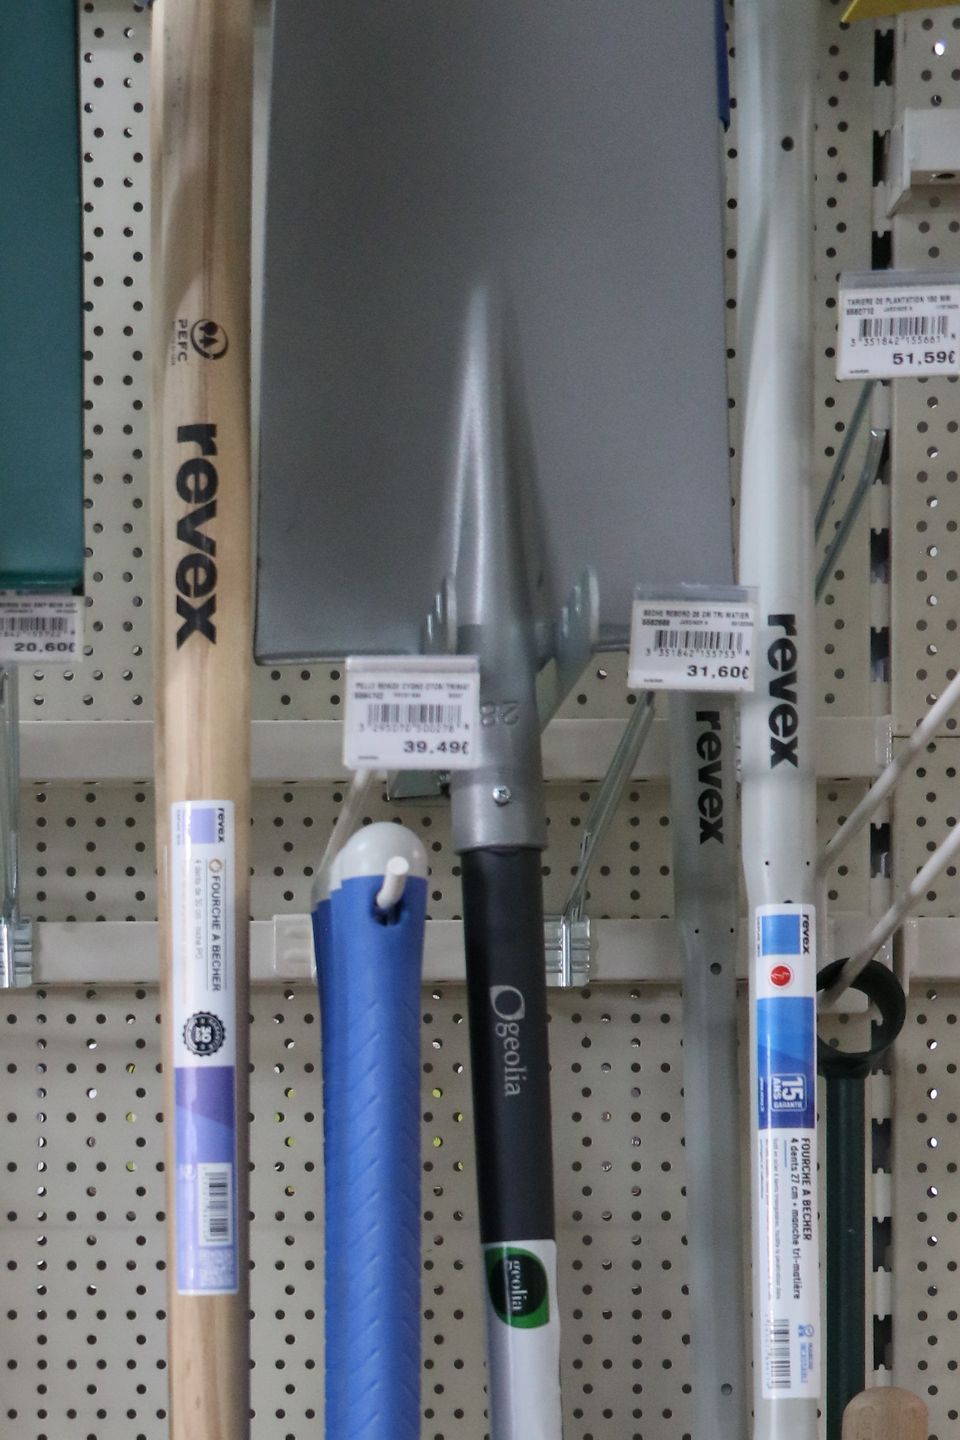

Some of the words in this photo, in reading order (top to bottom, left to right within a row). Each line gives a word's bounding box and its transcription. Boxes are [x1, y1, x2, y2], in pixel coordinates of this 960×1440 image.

[177, 318, 189, 363] PEFC
[892, 350, 956, 365] 51,59€
[176, 423, 218, 650] revex
[687, 665, 749, 679] 31,60€
[767, 613, 799, 769] revex
[695, 710, 724, 845] revex
[217, 807, 226, 843] revex
[211, 875, 222, 931] FOURCHE
[212, 933, 222, 942] A
[802, 914, 810, 954] revex
[211, 944, 222, 992] BECHER
[496, 1022, 527, 1096] geolia
[773, 1077, 781, 1100] ANS
[782, 1076, 804, 1100] 15
[791, 1146, 799, 1171] dents
[791, 1173, 799, 1183] 27
[801, 1138, 811, 1185] FOURCHE
[791, 1186, 798, 1200] cm
[792, 1209, 800, 1245] manche
[802, 1200, 812, 1241] BECHER
[507, 1260, 528, 1311] geolia
[793, 1248, 801, 1299] tri-matière
